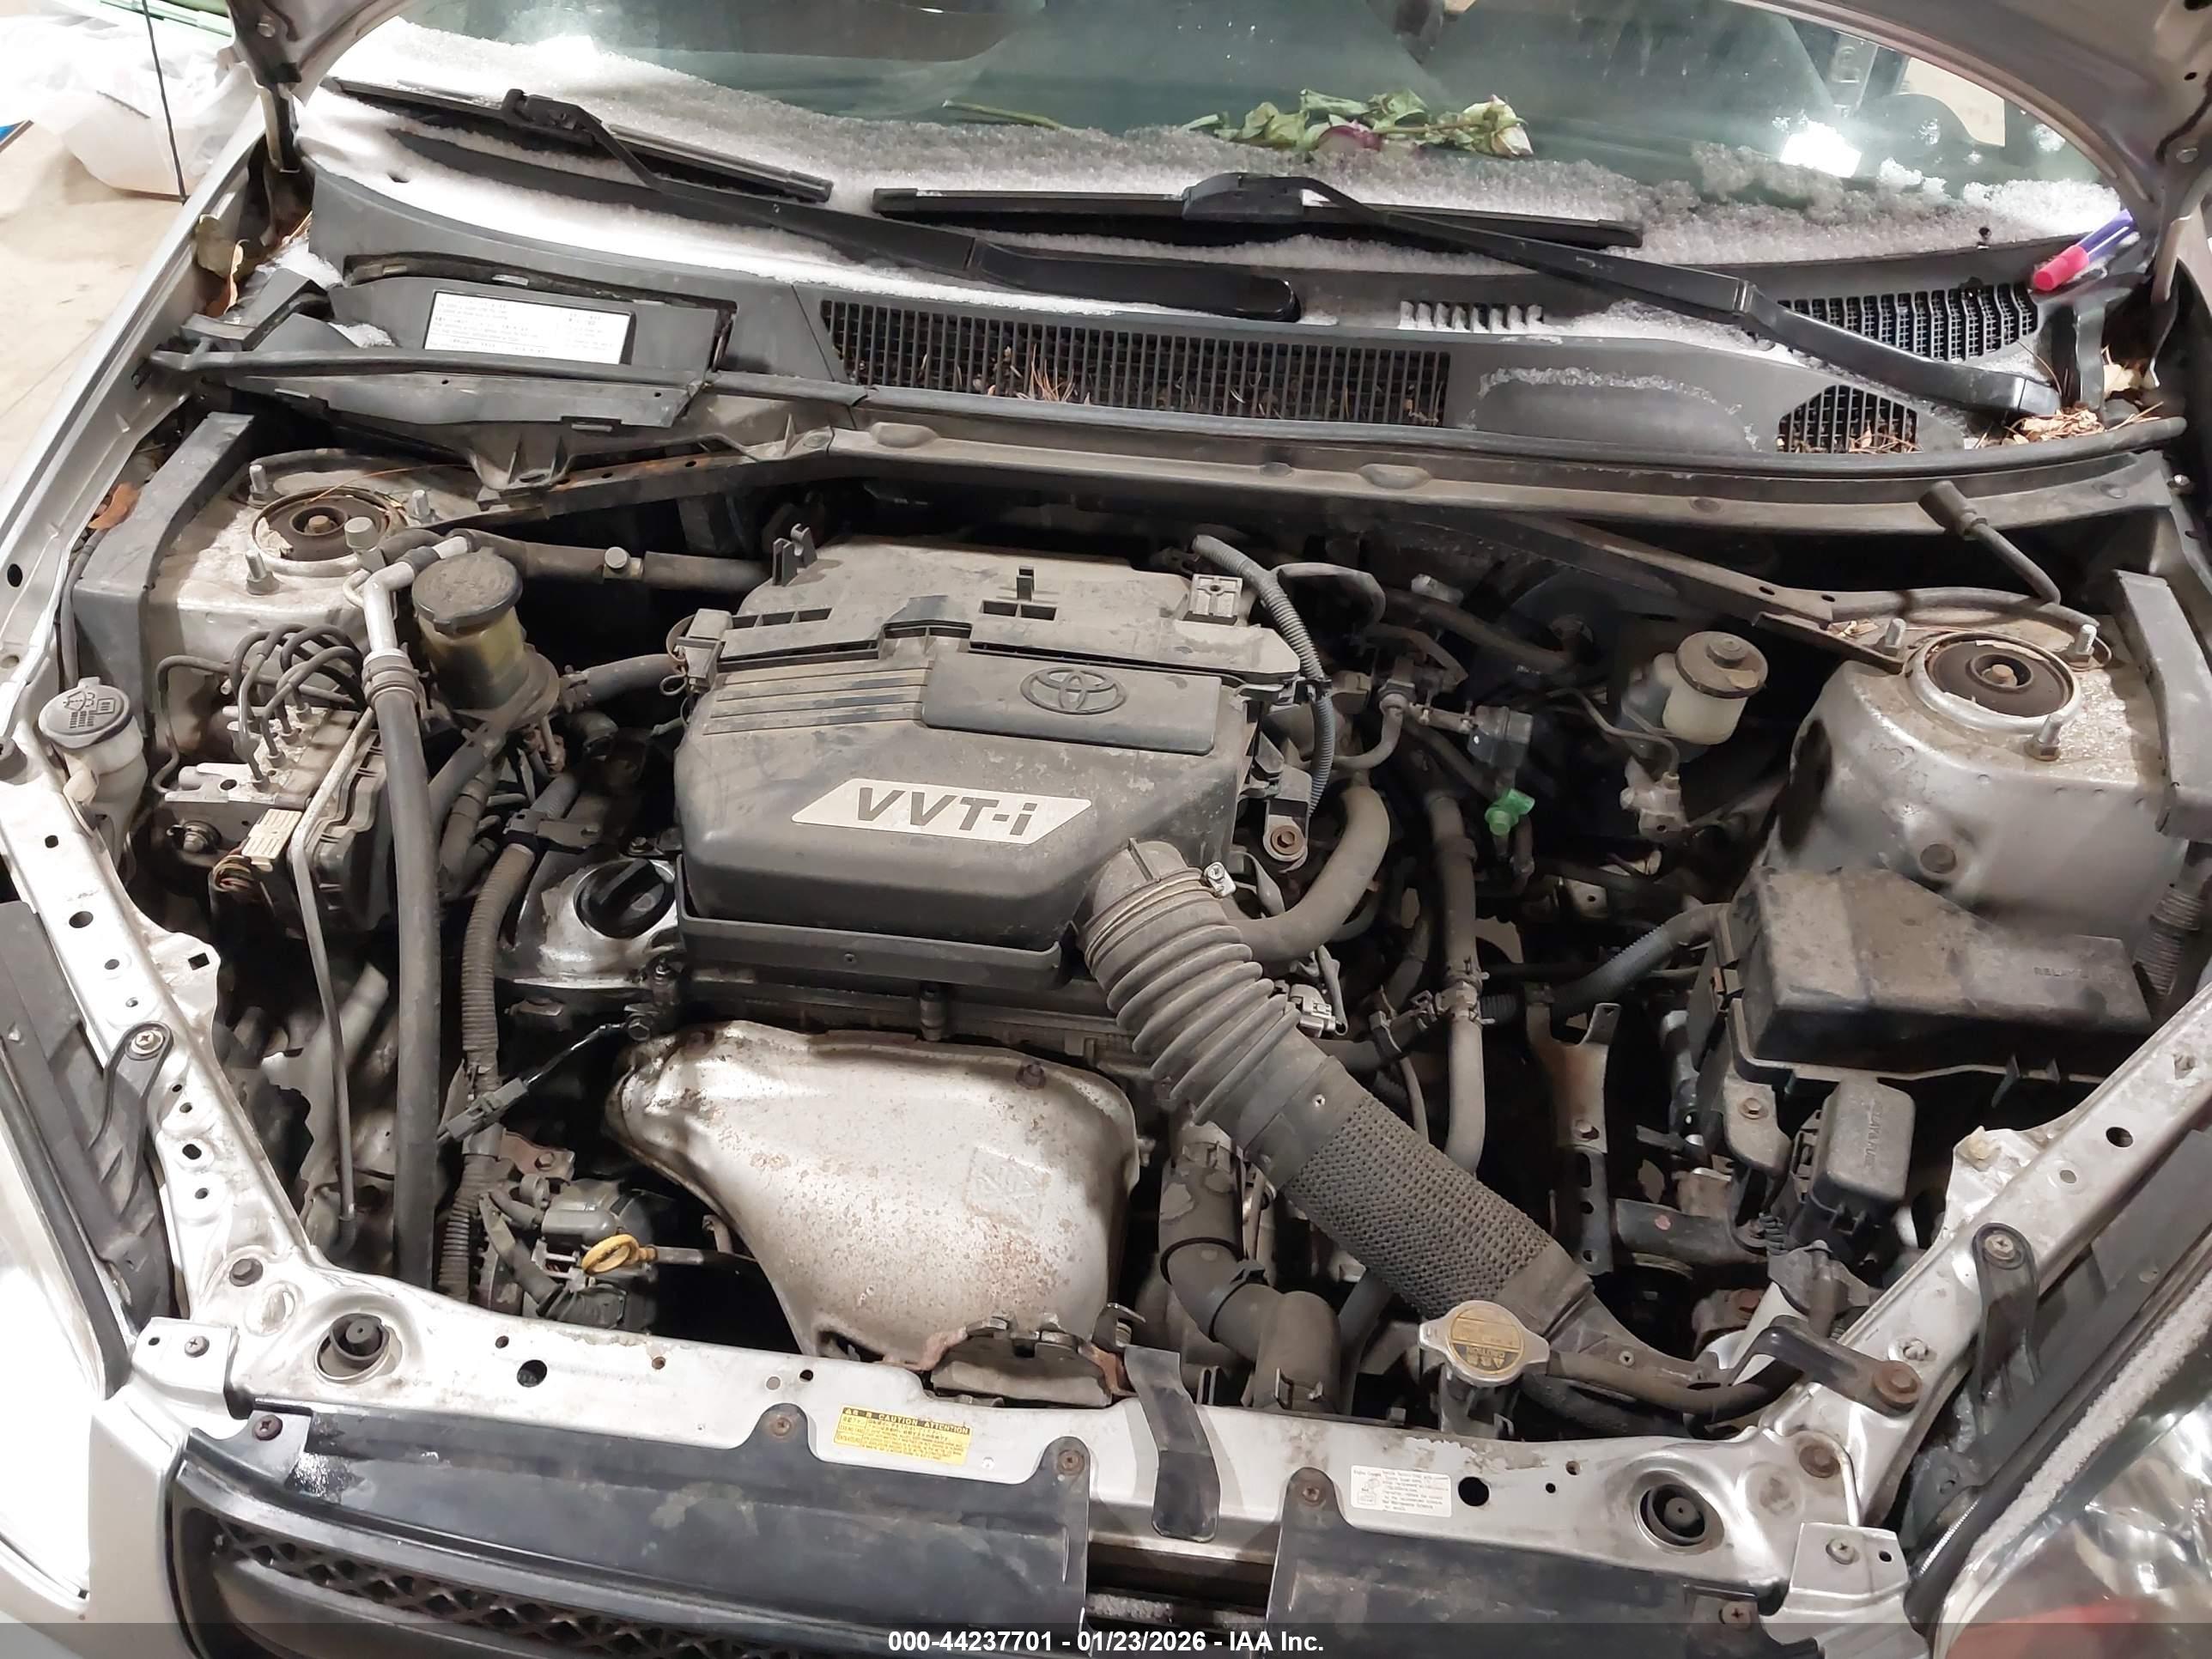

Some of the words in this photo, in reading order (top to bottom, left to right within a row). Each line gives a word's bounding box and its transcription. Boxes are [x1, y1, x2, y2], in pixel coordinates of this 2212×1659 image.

[857, 787, 1038, 836] VVT-i
[878, 1413, 919, 1426] CAUTION
[924, 1420, 969, 1434] ATTENTION
